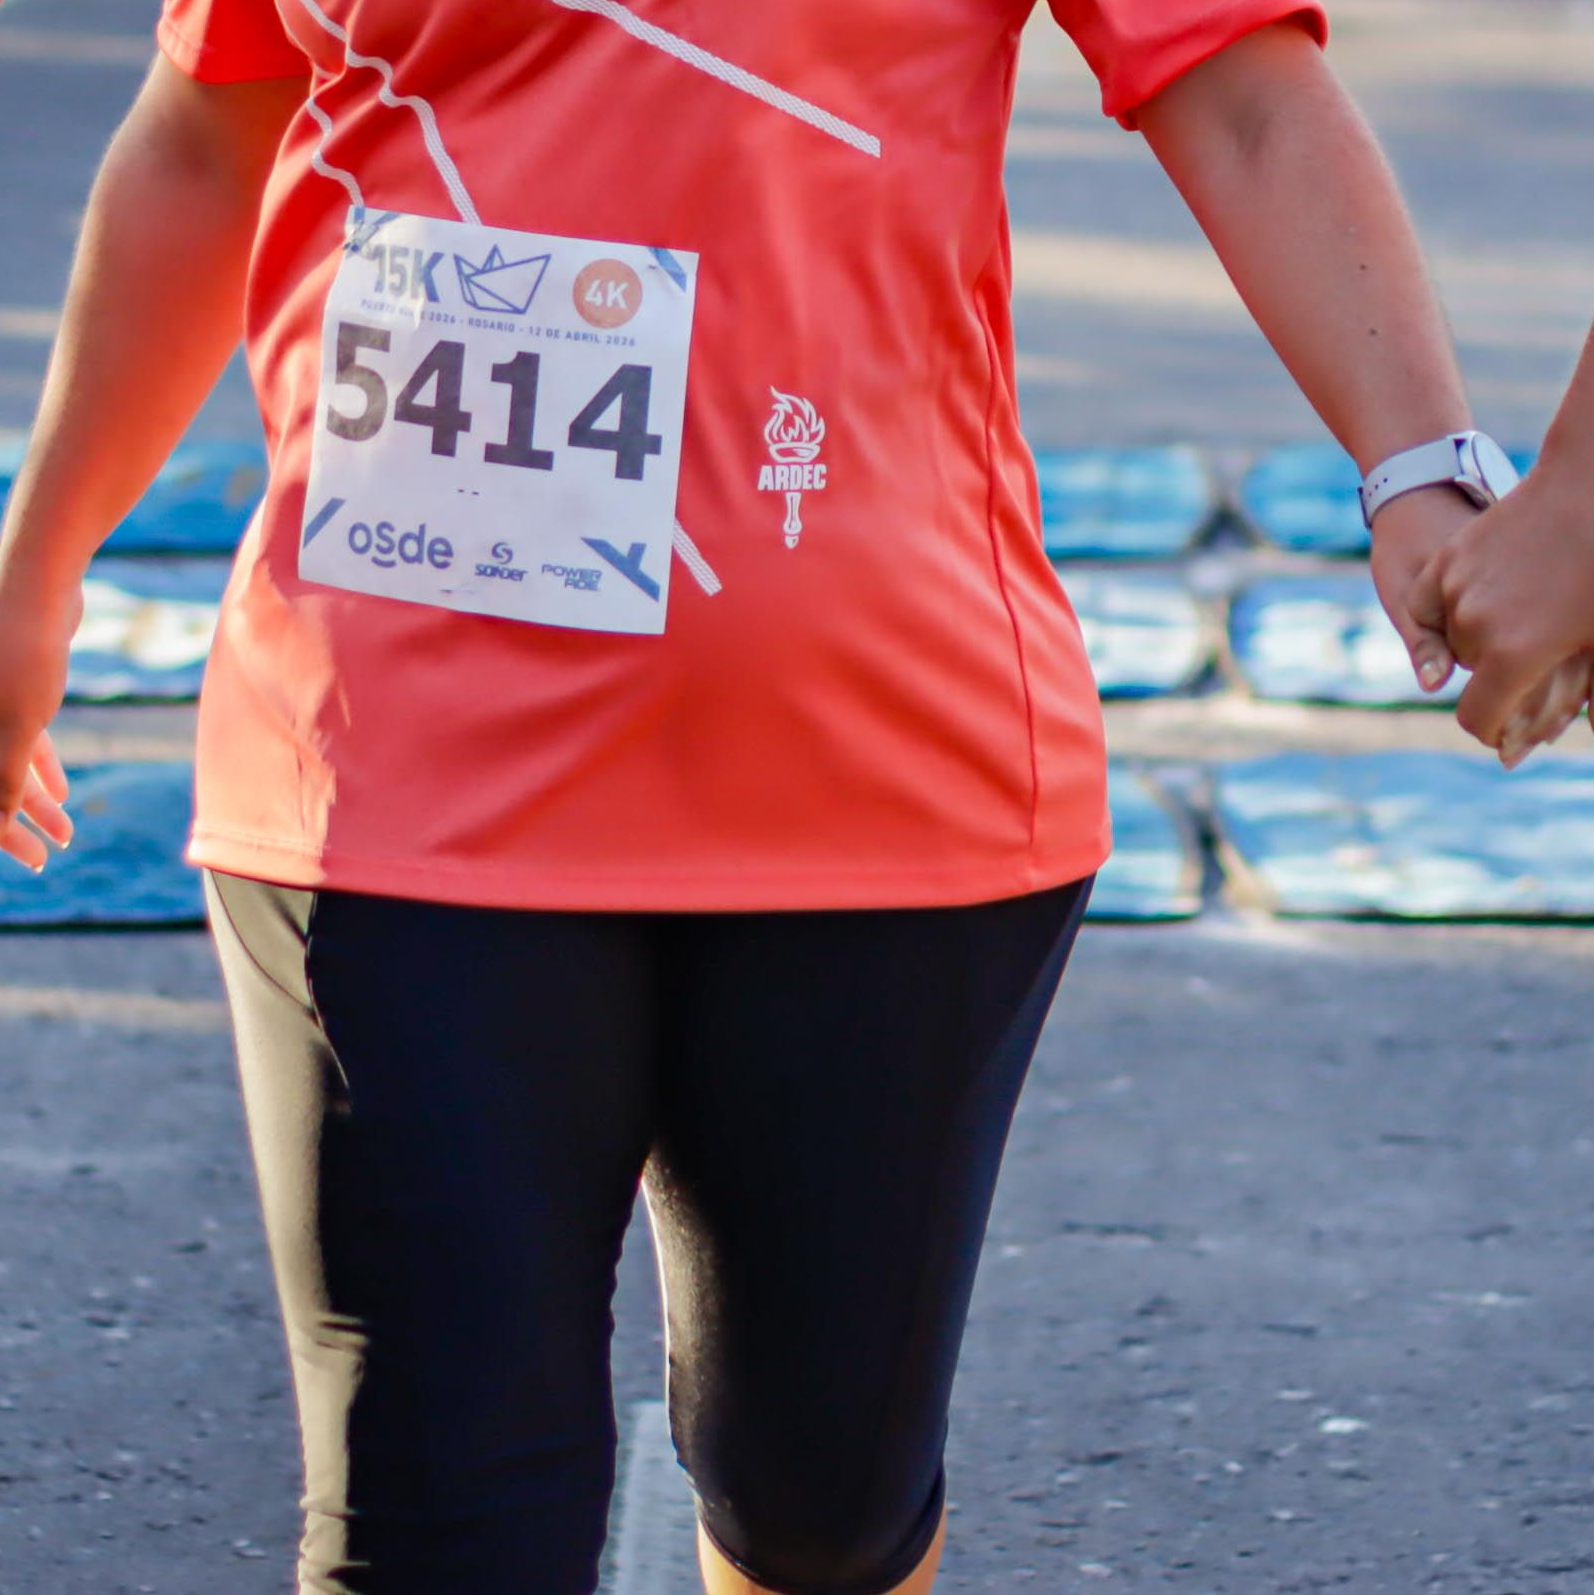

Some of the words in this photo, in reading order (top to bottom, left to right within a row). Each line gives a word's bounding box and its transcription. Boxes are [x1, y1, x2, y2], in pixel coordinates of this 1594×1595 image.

[371, 244, 444, 303] 15K
[584, 279, 629, 308] 4K
[468, 317, 515, 333] ROSARIO
[529, 326, 541, 337] 12
[546, 328, 560, 339] DE
[565, 331, 599, 344] ABRIL
[325, 321, 662, 482] 5414
[757, 464, 827, 491] ARDEC
[348, 521, 454, 570] osde
[541, 564, 603, 581] POWER
